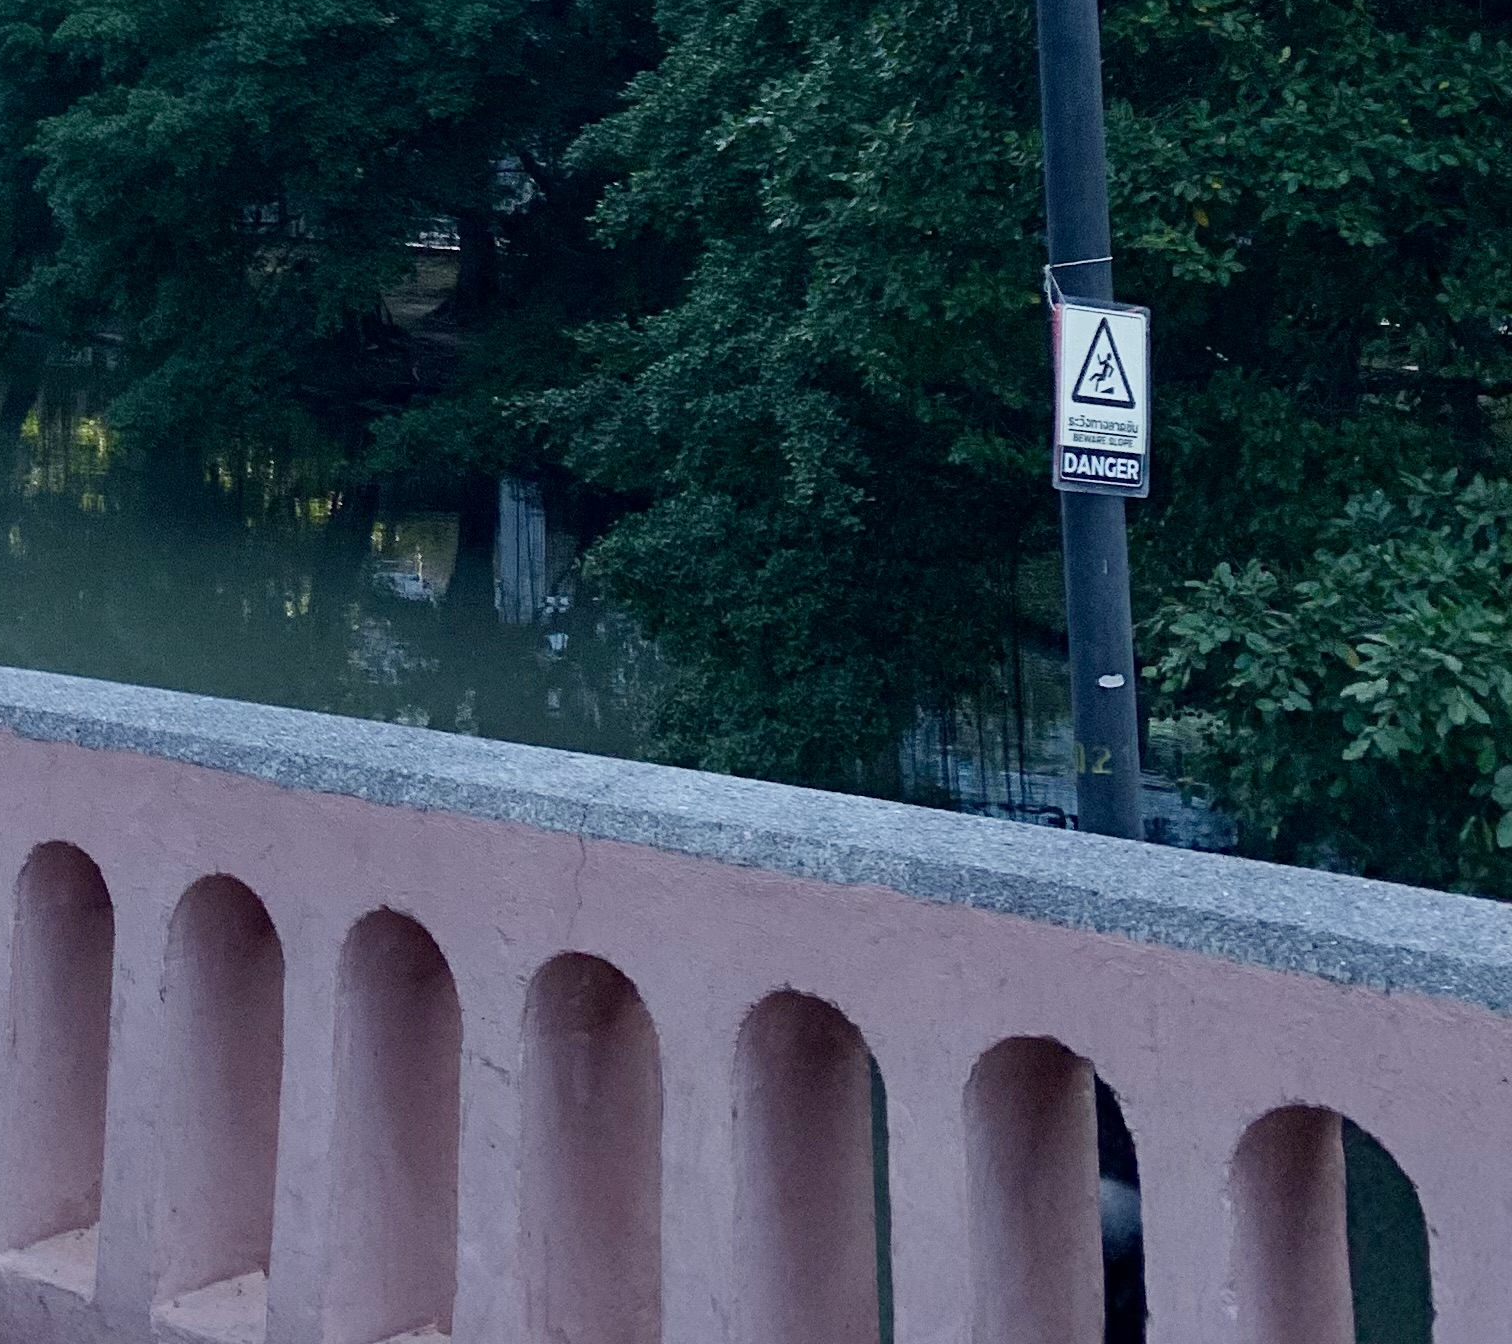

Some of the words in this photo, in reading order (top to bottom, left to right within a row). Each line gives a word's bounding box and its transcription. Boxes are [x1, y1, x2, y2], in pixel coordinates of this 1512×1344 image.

[1073, 433, 1106, 445] BEWARE
[1109, 437, 1134, 448] SLOPE
[1063, 452, 1139, 481] DANGER
